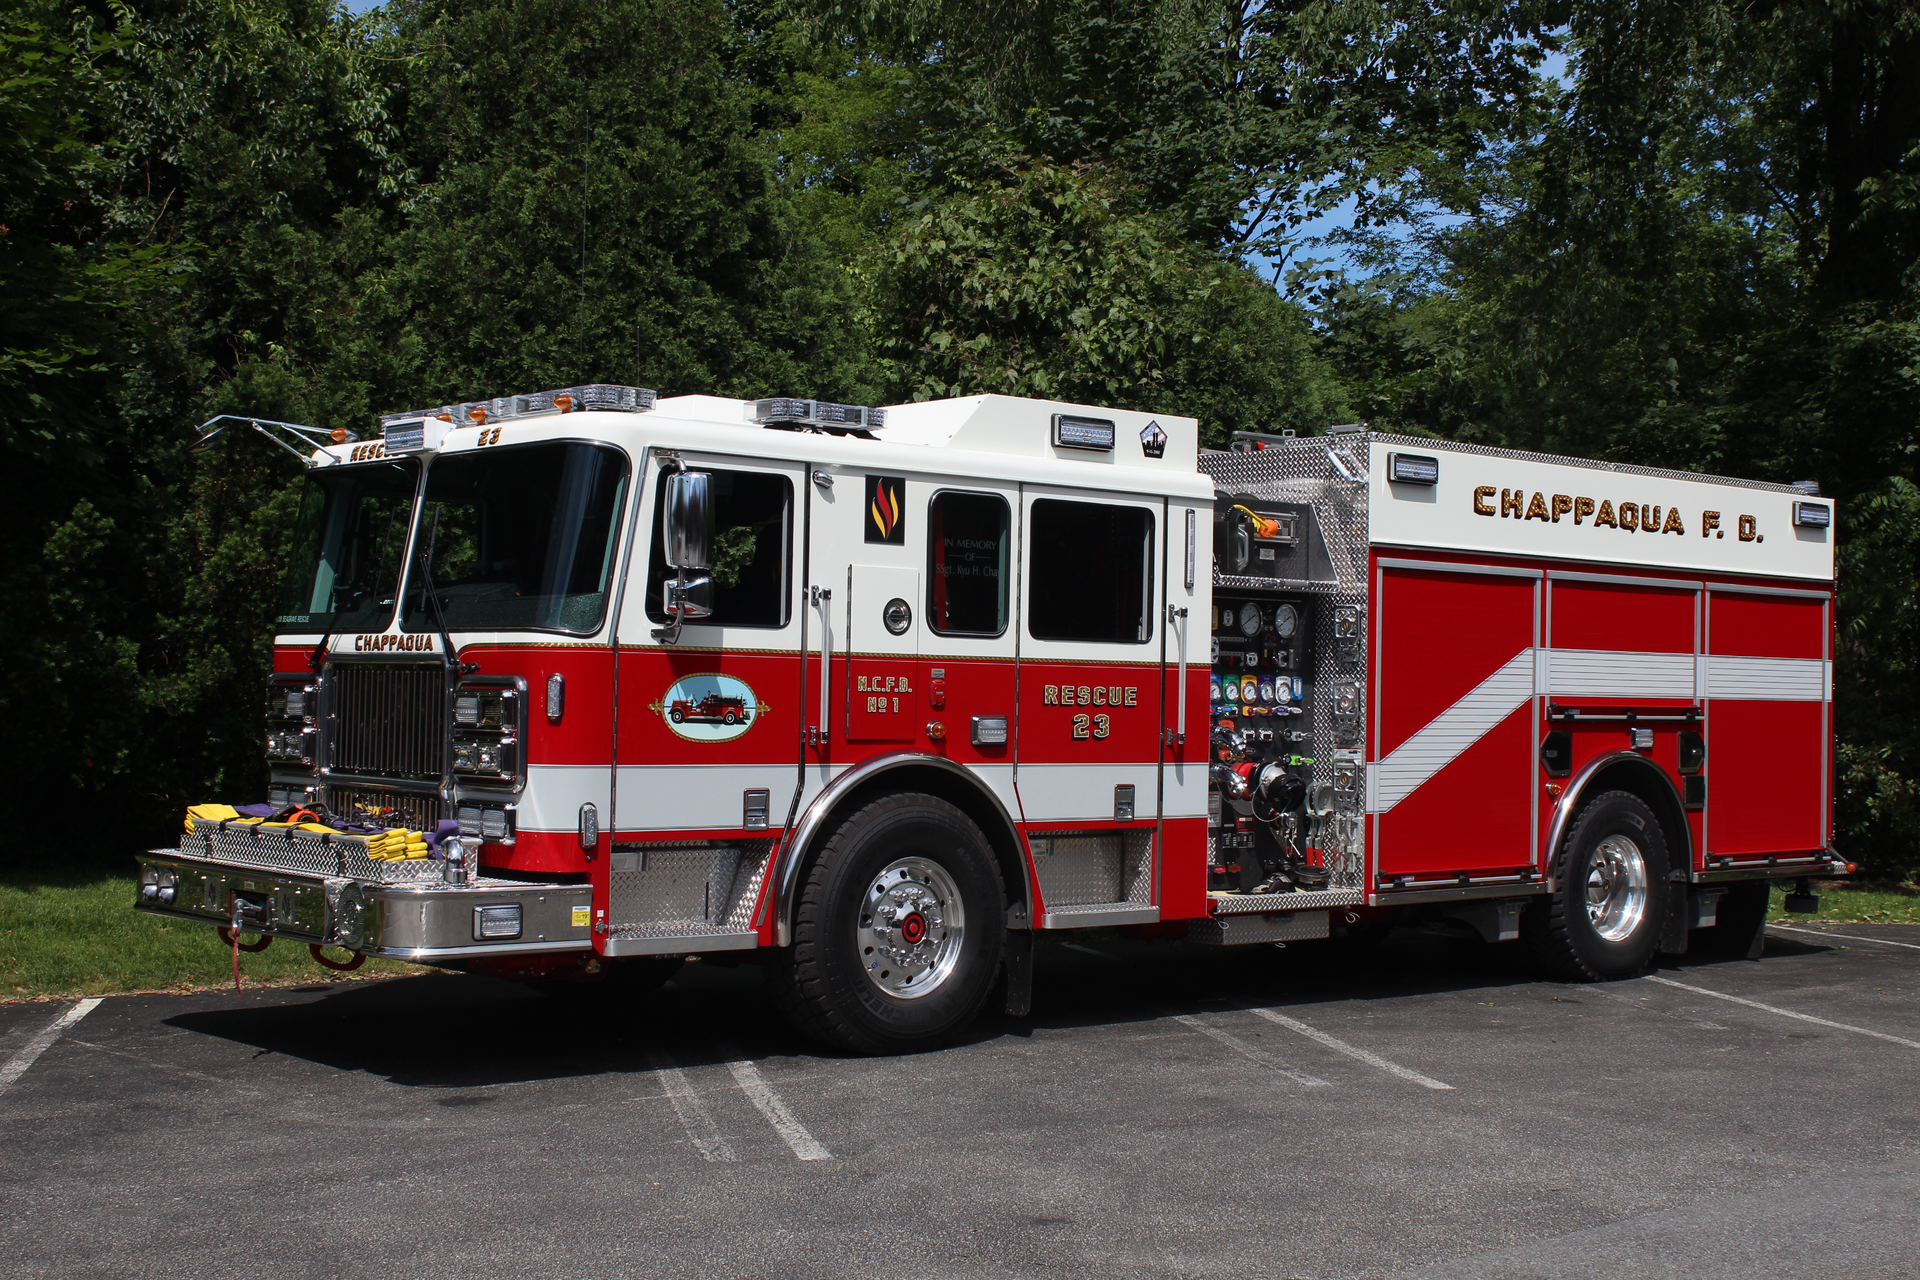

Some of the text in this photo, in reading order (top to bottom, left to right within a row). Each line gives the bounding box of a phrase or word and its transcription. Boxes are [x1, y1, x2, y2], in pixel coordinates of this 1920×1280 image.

[350, 427, 502, 462] RESC 23
[1473, 485, 1765, 543] CHAPPAQUA F. D.
[944, 538, 997, 550] IN MEMORY
[964, 552, 976, 562] OF
[935, 563, 955, 578] SSgt.
[957, 564, 970, 578] Kyu
[972, 565, 981, 576] H.
[354, 634, 434, 652] CHAPPAQUA
[857, 675, 913, 693] N.C.F.D.
[892, 697, 899, 713] 1
[1043, 684, 1138, 708] RESCUE
[1072, 713, 1110, 741] 23
